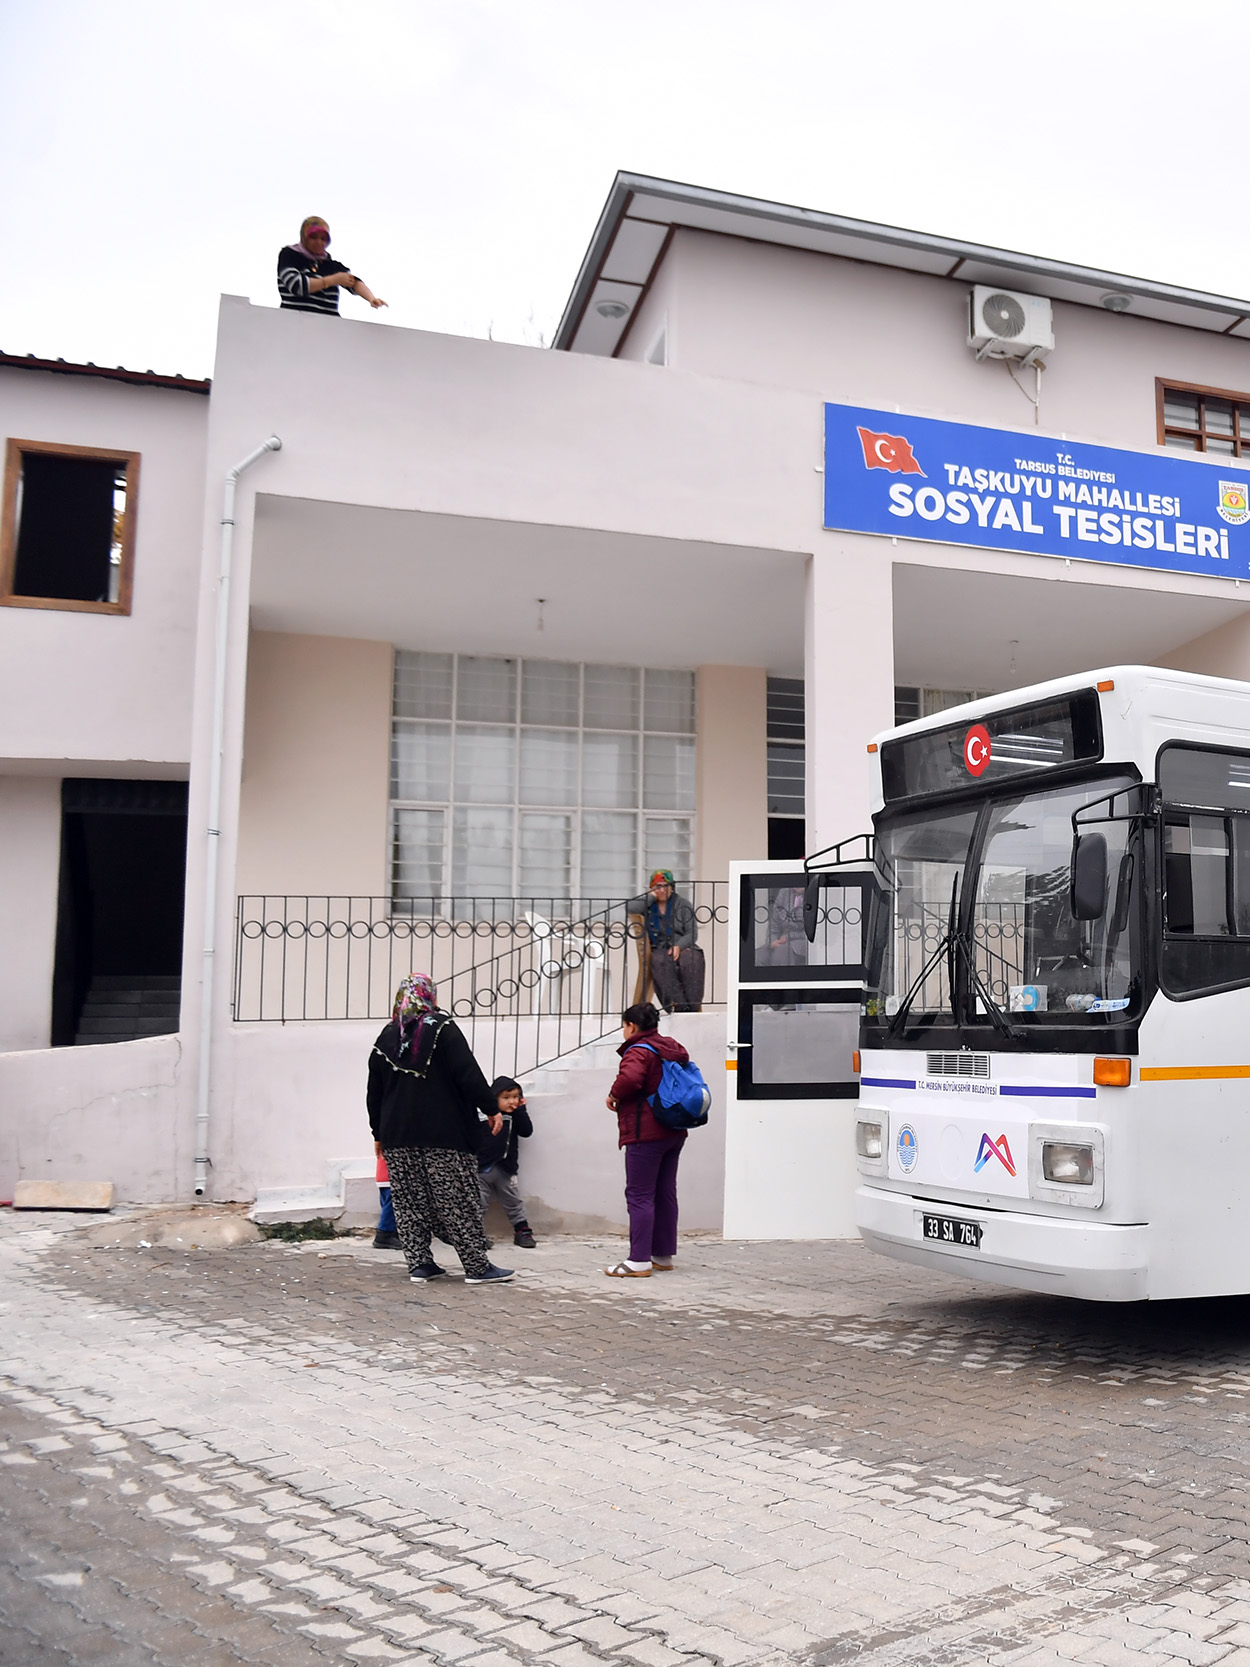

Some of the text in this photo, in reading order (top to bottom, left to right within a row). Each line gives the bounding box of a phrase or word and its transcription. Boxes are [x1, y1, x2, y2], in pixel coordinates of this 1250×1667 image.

[1014, 458, 1116, 484] TARSUS BELEDİYESİ
[1056, 453, 1075, 465] T.C.
[944, 463, 1181, 518] TAŞKUYU MAHALLESİ
[888, 482, 1230, 560] SOSYAL TESİSLERİ
[928, 1218, 977, 1245] 33 SA 764
